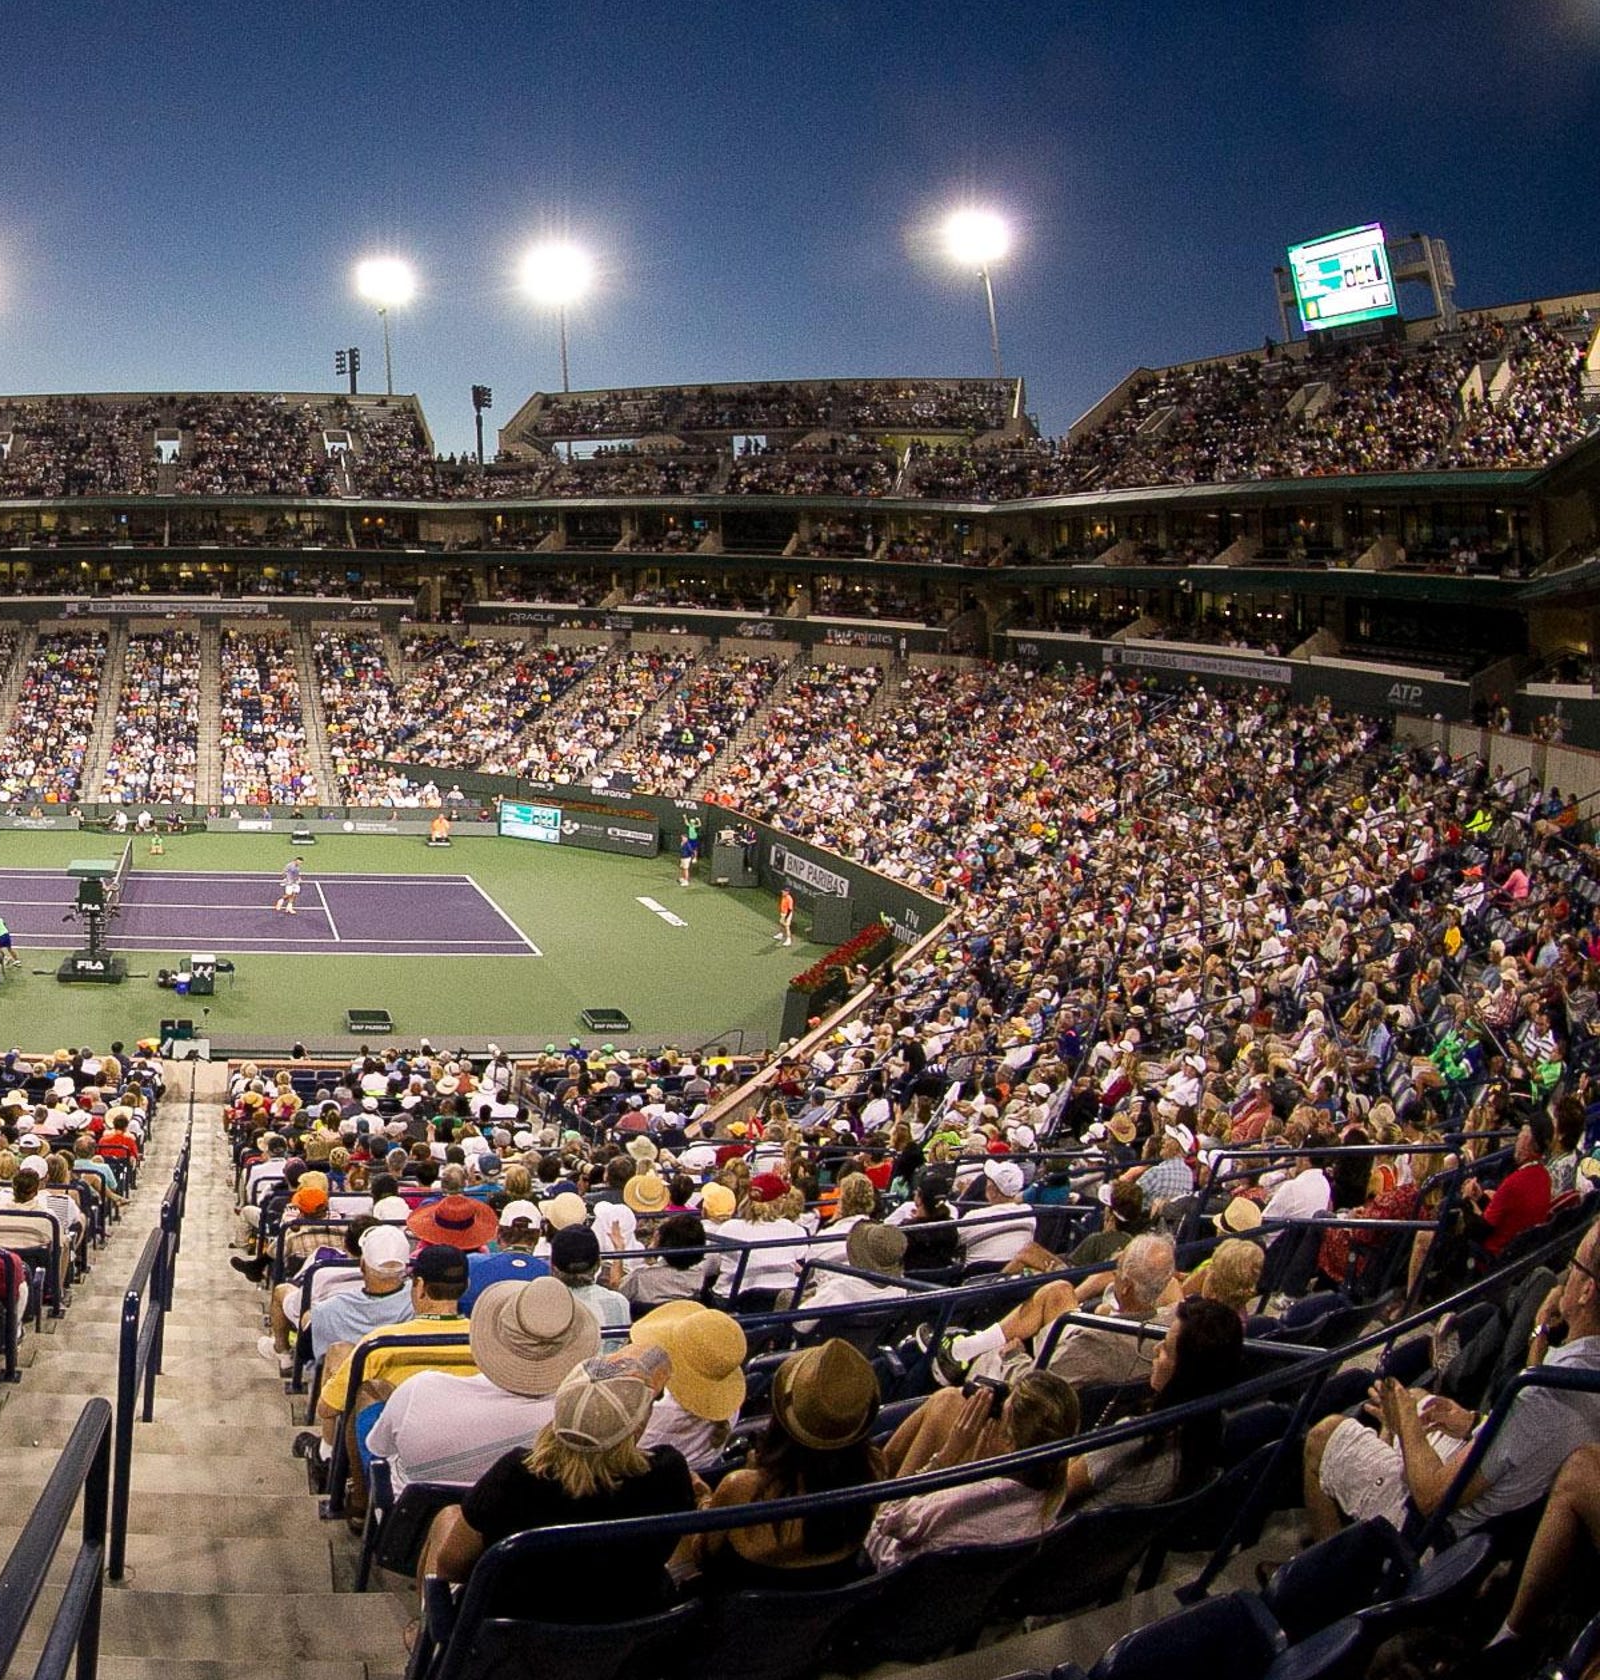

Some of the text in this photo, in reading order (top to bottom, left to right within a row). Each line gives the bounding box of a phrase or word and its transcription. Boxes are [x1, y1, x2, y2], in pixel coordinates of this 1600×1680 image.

[350, 606, 378, 617] ATP
[508, 612, 555, 623] ORACLE
[1388, 682, 1423, 699] ATP
[591, 788, 632, 800] esurance
[674, 799, 698, 811] WTA
[787, 855, 805, 876] BNP
[807, 865, 845, 897] PARIBAS
[81, 903, 101, 911] FILA
[76, 960, 105, 970] FILA
